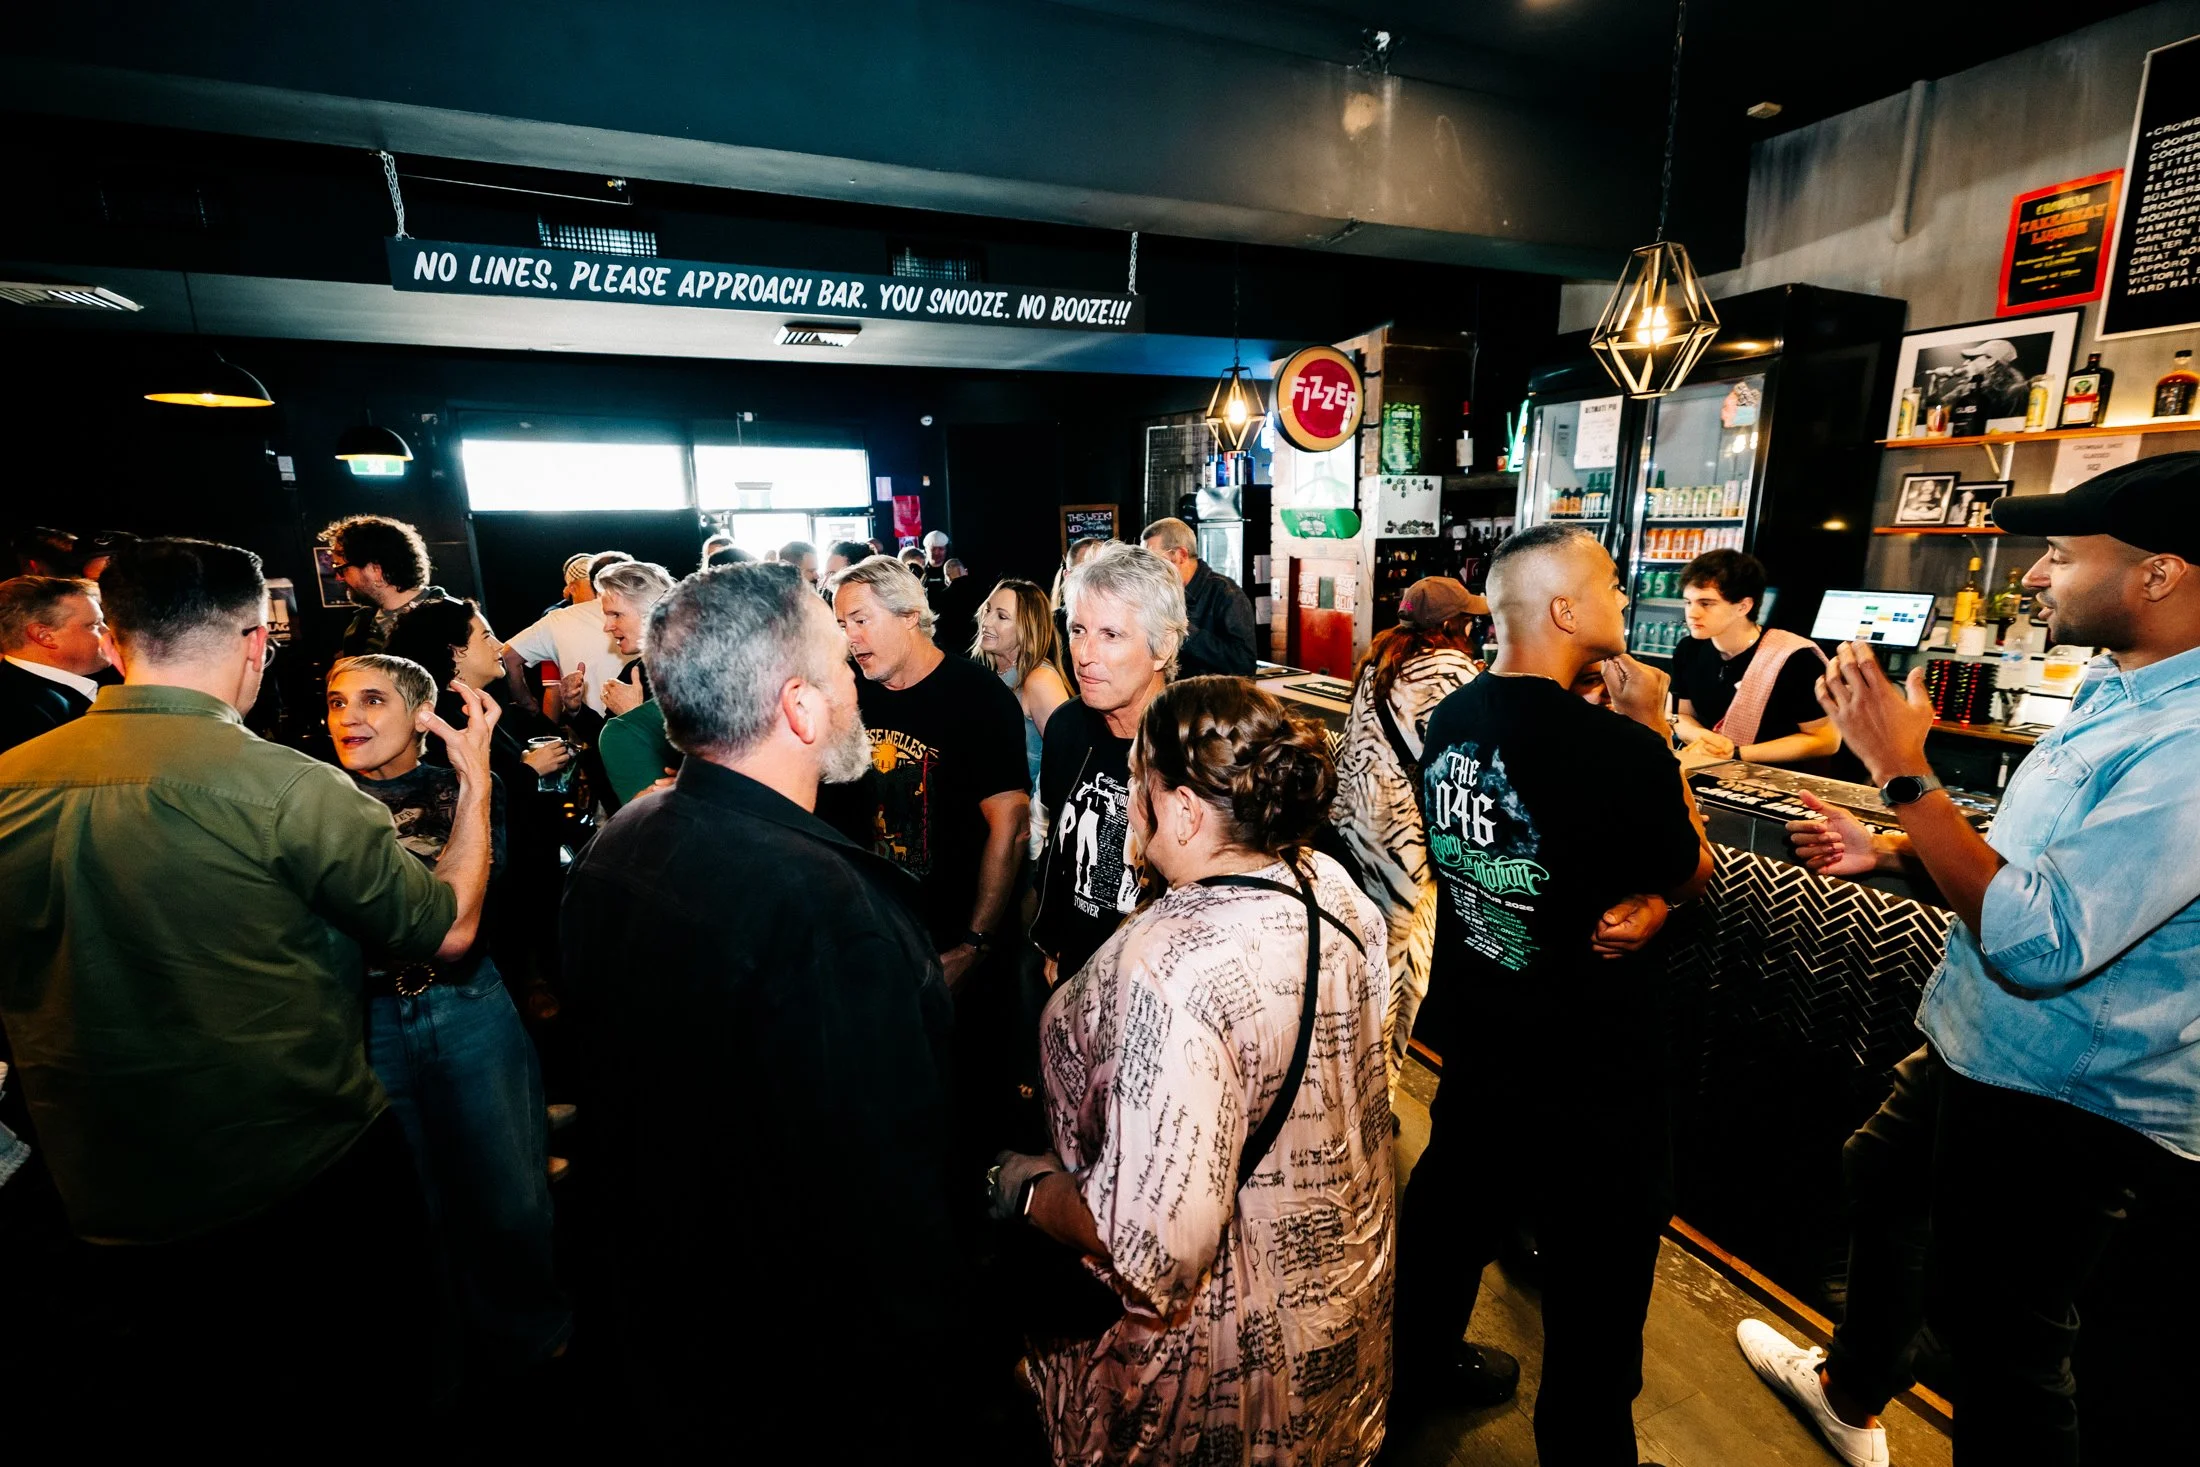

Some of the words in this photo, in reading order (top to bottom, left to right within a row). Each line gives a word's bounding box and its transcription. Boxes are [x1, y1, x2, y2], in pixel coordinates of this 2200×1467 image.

[2153, 116, 2200, 136] CROWB
[2152, 131, 2200, 150] COOPER
[2149, 142, 2200, 161] COOPER
[2144, 174, 2200, 193] RESCH
[2141, 194, 2200, 214] BROOKVA
[413, 251, 457, 281] NO
[569, 261, 671, 296] PLEASE
[677, 270, 812, 306] APPROACH
[817, 279, 867, 309] BAR.
[879, 283, 924, 313] YOU
[926, 288, 1010, 319] SNOOZE.
[1017, 294, 1046, 320] NO
[1050, 297, 1132, 325] BOOZE!!!
[2169, 277, 2200, 288] RAT
[1289, 375, 1358, 420] FIZZER
[1067, 513, 1086, 522] THIS
[884, 729, 928, 760] WELLES
[1446, 751, 1480, 788] THE
[1435, 779, 1497, 848] 046
[1073, 894, 1100, 918] FOREVER
